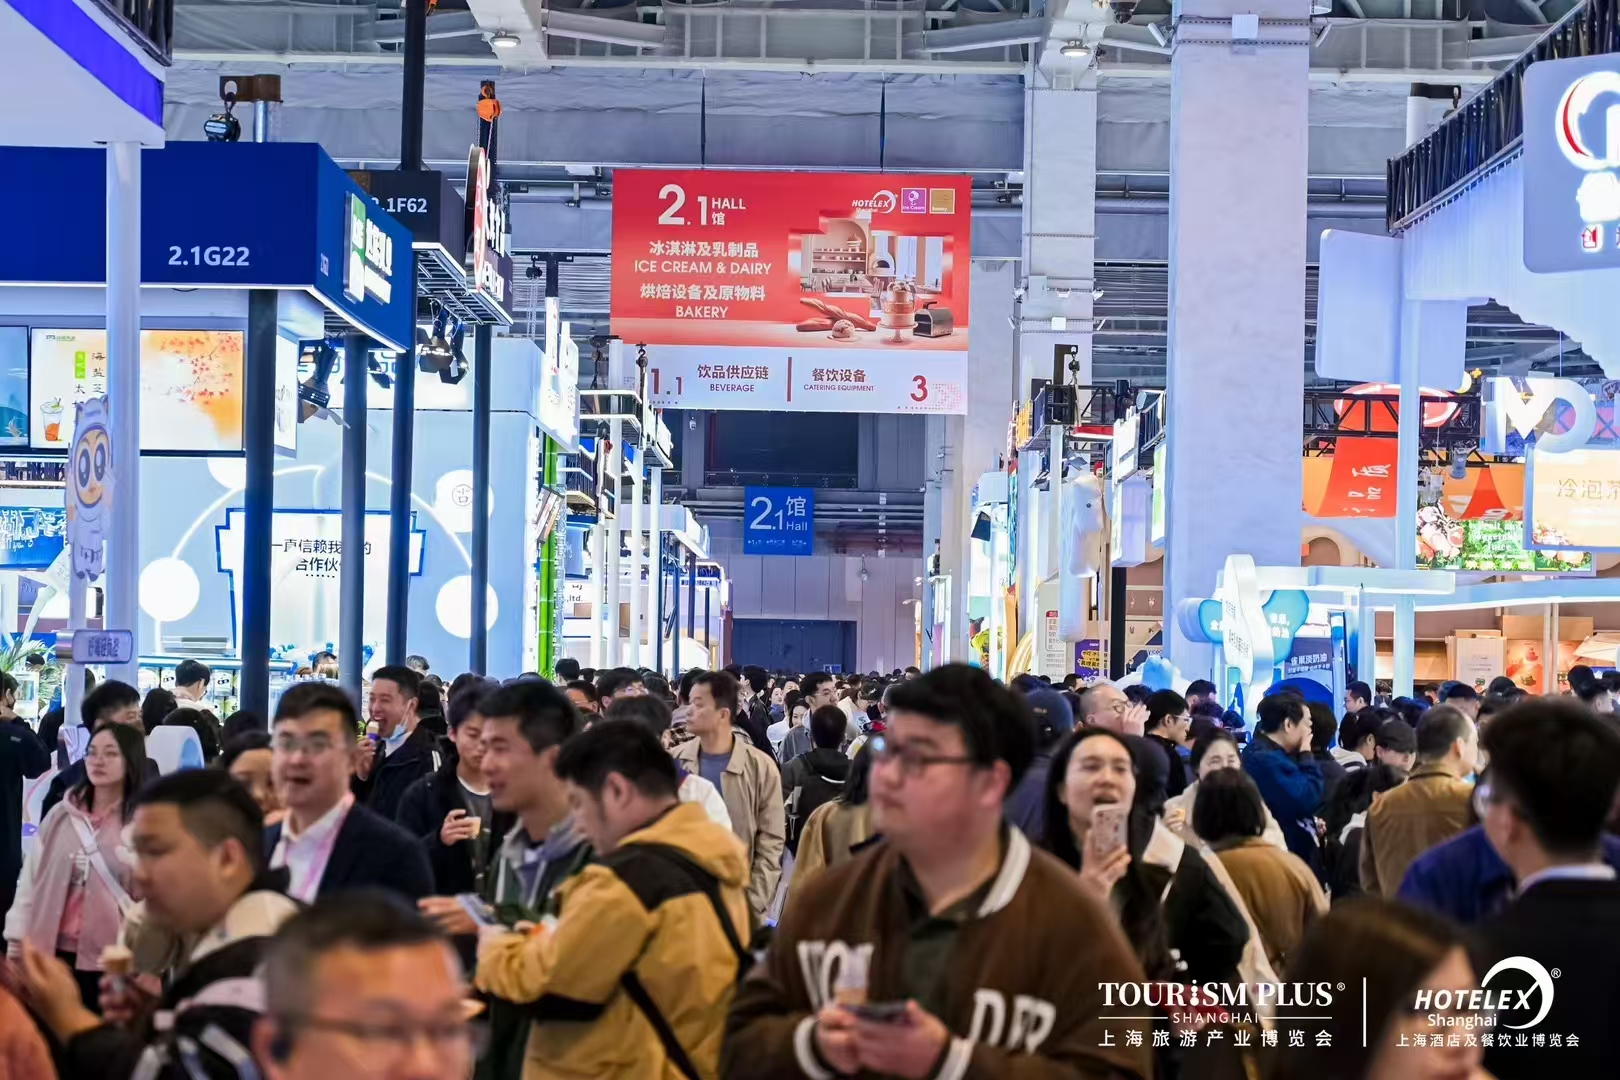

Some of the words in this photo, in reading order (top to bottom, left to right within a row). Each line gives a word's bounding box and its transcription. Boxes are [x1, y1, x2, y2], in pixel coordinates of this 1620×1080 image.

[658, 183, 708, 226] 2.1
[711, 197, 747, 210] HALL
[852, 199, 889, 208] HOTELEX
[711, 211, 726, 226] 馆
[168, 245, 250, 267] 2.1G22
[649, 240, 759, 258] 冰淇淋及乳制品
[634, 260, 657, 273] ICE
[661, 260, 712, 274] CREAM
[716, 261, 726, 274] &
[730, 262, 772, 275] DAIRY
[640, 283, 765, 302] 烘焙设备及原物料
[676, 305, 728, 318] BAKERY
[697, 364, 769, 380] 饮品供应链
[812, 367, 867, 384] 餐饮设备
[709, 383, 755, 392] BEVERAGE
[837, 384, 874, 392] EQUIPMENT
[910, 374, 928, 402] 3
[750, 496, 783, 531] 2.1
[786, 495, 807, 517] 馆
[786, 520, 808, 531] Hall
[295, 557, 341, 572] 合作伙
